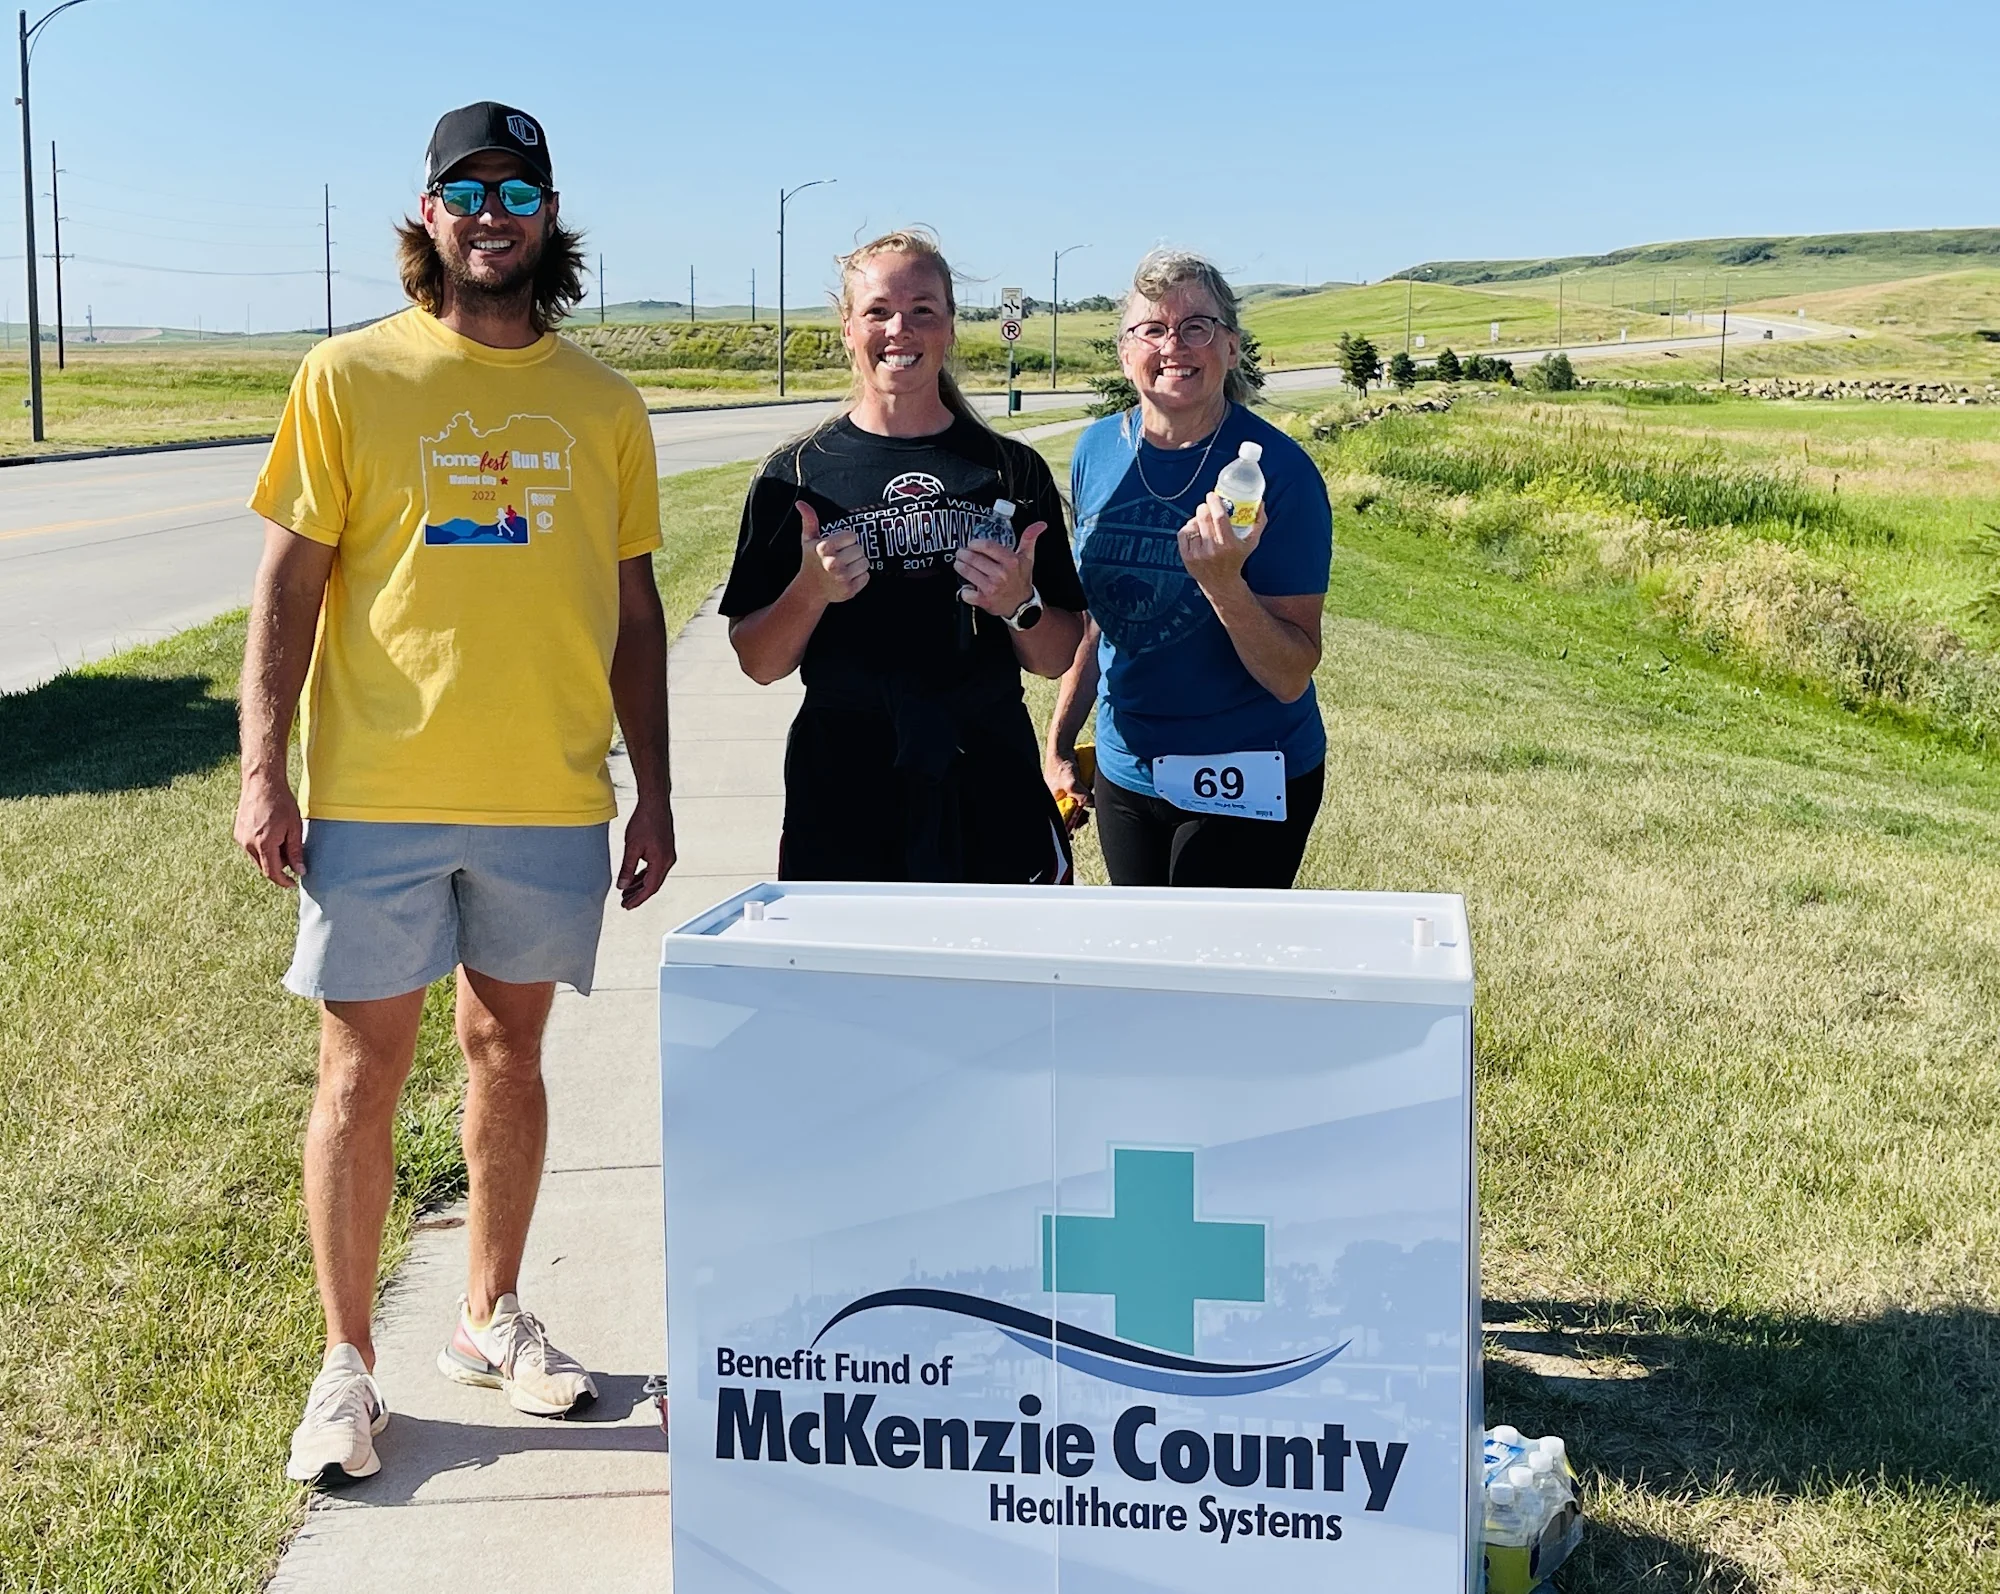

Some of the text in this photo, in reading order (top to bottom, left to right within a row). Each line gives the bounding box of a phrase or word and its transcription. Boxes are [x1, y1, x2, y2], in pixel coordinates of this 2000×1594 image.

[511, 451, 539, 469] Run
[543, 452, 561, 470] 5K
[472, 490, 496, 501] 2022
[821, 497, 993, 532] WATFORD CITY WOLVE
[903, 557, 934, 570] 2017
[1193, 766, 1244, 800] 69
[717, 1347, 954, 1386] Benefit Fund of
[716, 1387, 1409, 1512] McKenzie County
[989, 1483, 1344, 1544] Healthcare Systems
